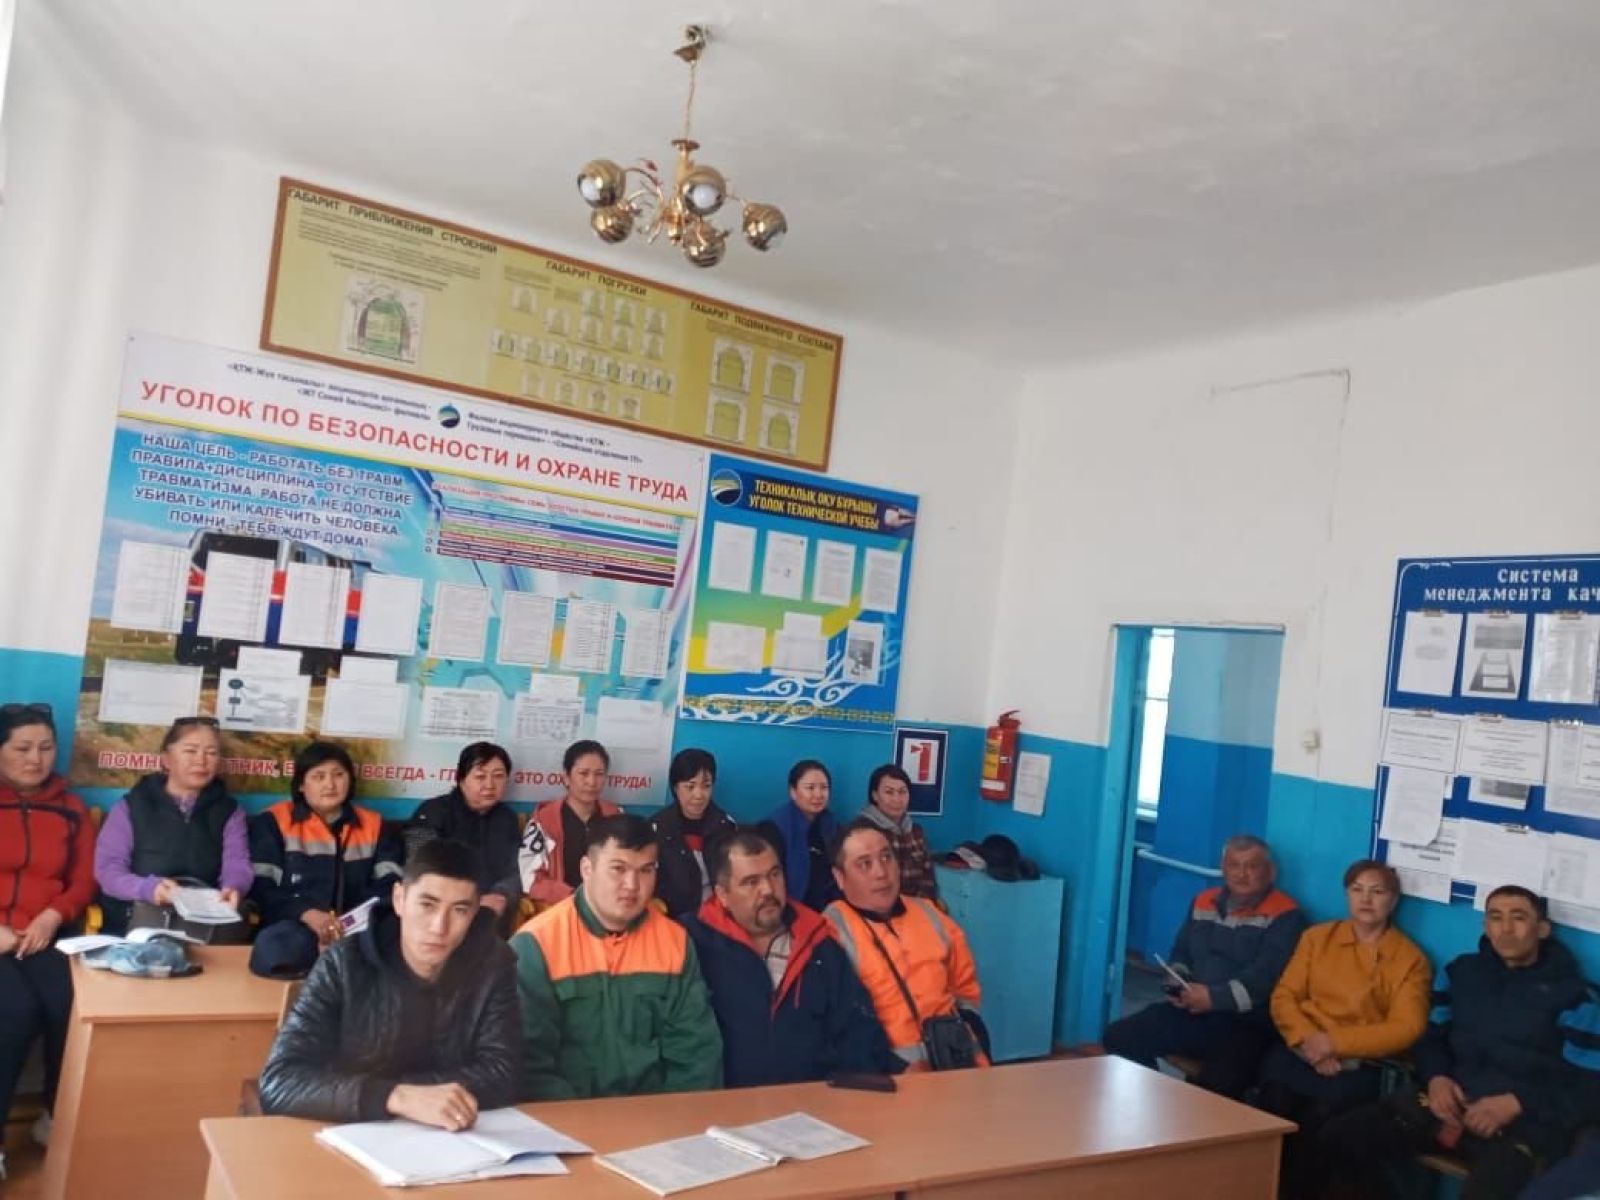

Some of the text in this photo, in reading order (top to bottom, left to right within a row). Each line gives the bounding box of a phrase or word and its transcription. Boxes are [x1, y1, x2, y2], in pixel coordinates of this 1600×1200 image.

[287, 188, 340, 212] ГАБАРИТ
[348, 204, 433, 237] ПРИБЛИЖЕНИЯ
[141, 380, 689, 502] УГОЛОК ПО БЕЗОПАСНОСТИ И ОХРАНЕ ТРУДА
[143, 433, 191, 451] НАША
[196, 442, 236, 460] ЦЕЛЬ
[250, 451, 322, 473] РАБОТАТЬ
[327, 465, 354, 479] БЕЗ
[358, 470, 402, 487] ТРАВМ
[135, 486, 206, 507] УБИВАТЬ
[211, 499, 241, 512] ИЛИ
[245, 503, 321, 524] КАЛЕЧИТЬ
[261, 487, 317, 506] РАБОТА
[321, 498, 339, 510] НЕ
[342, 501, 401, 519] ДОЛЖНА
[749, 494, 784, 512] УГОЛОК
[170, 510, 226, 527] ПОМНИ
[239, 519, 276, 533] ТЕБЯ
[1497, 567, 1579, 584] Система
[1423, 586, 1552, 603] менеджмента
[362, 765, 425, 781] ВСЕГДА
[515, 771, 543, 785] ЭТО
[608, 774, 652, 790] ТРУДА!
